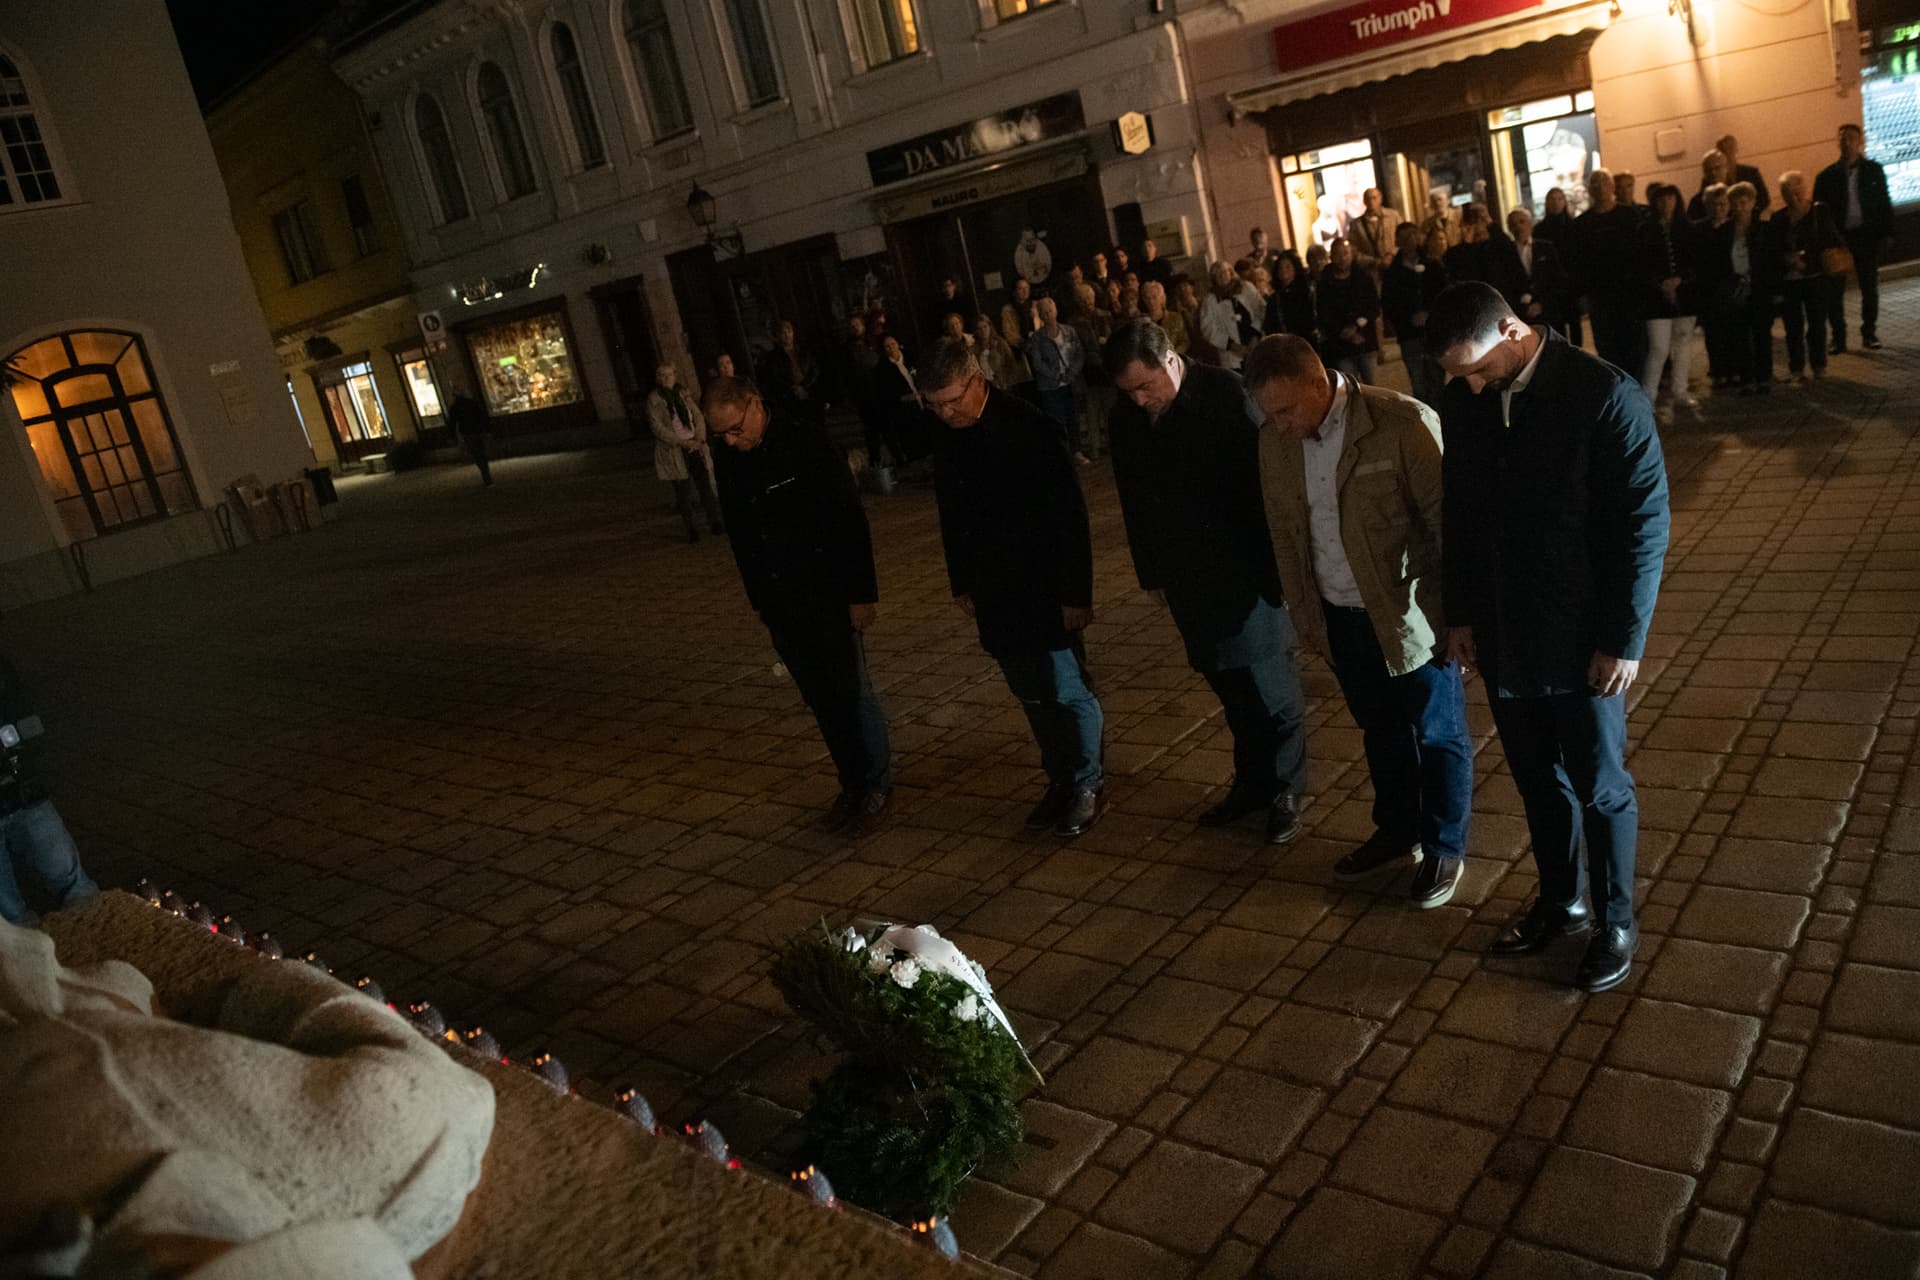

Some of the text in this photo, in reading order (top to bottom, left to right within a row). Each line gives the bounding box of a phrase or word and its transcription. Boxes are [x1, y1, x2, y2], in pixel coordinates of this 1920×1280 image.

[1350, 1, 1436, 40] Triumph
[904, 114, 1041, 175] DA MAR
